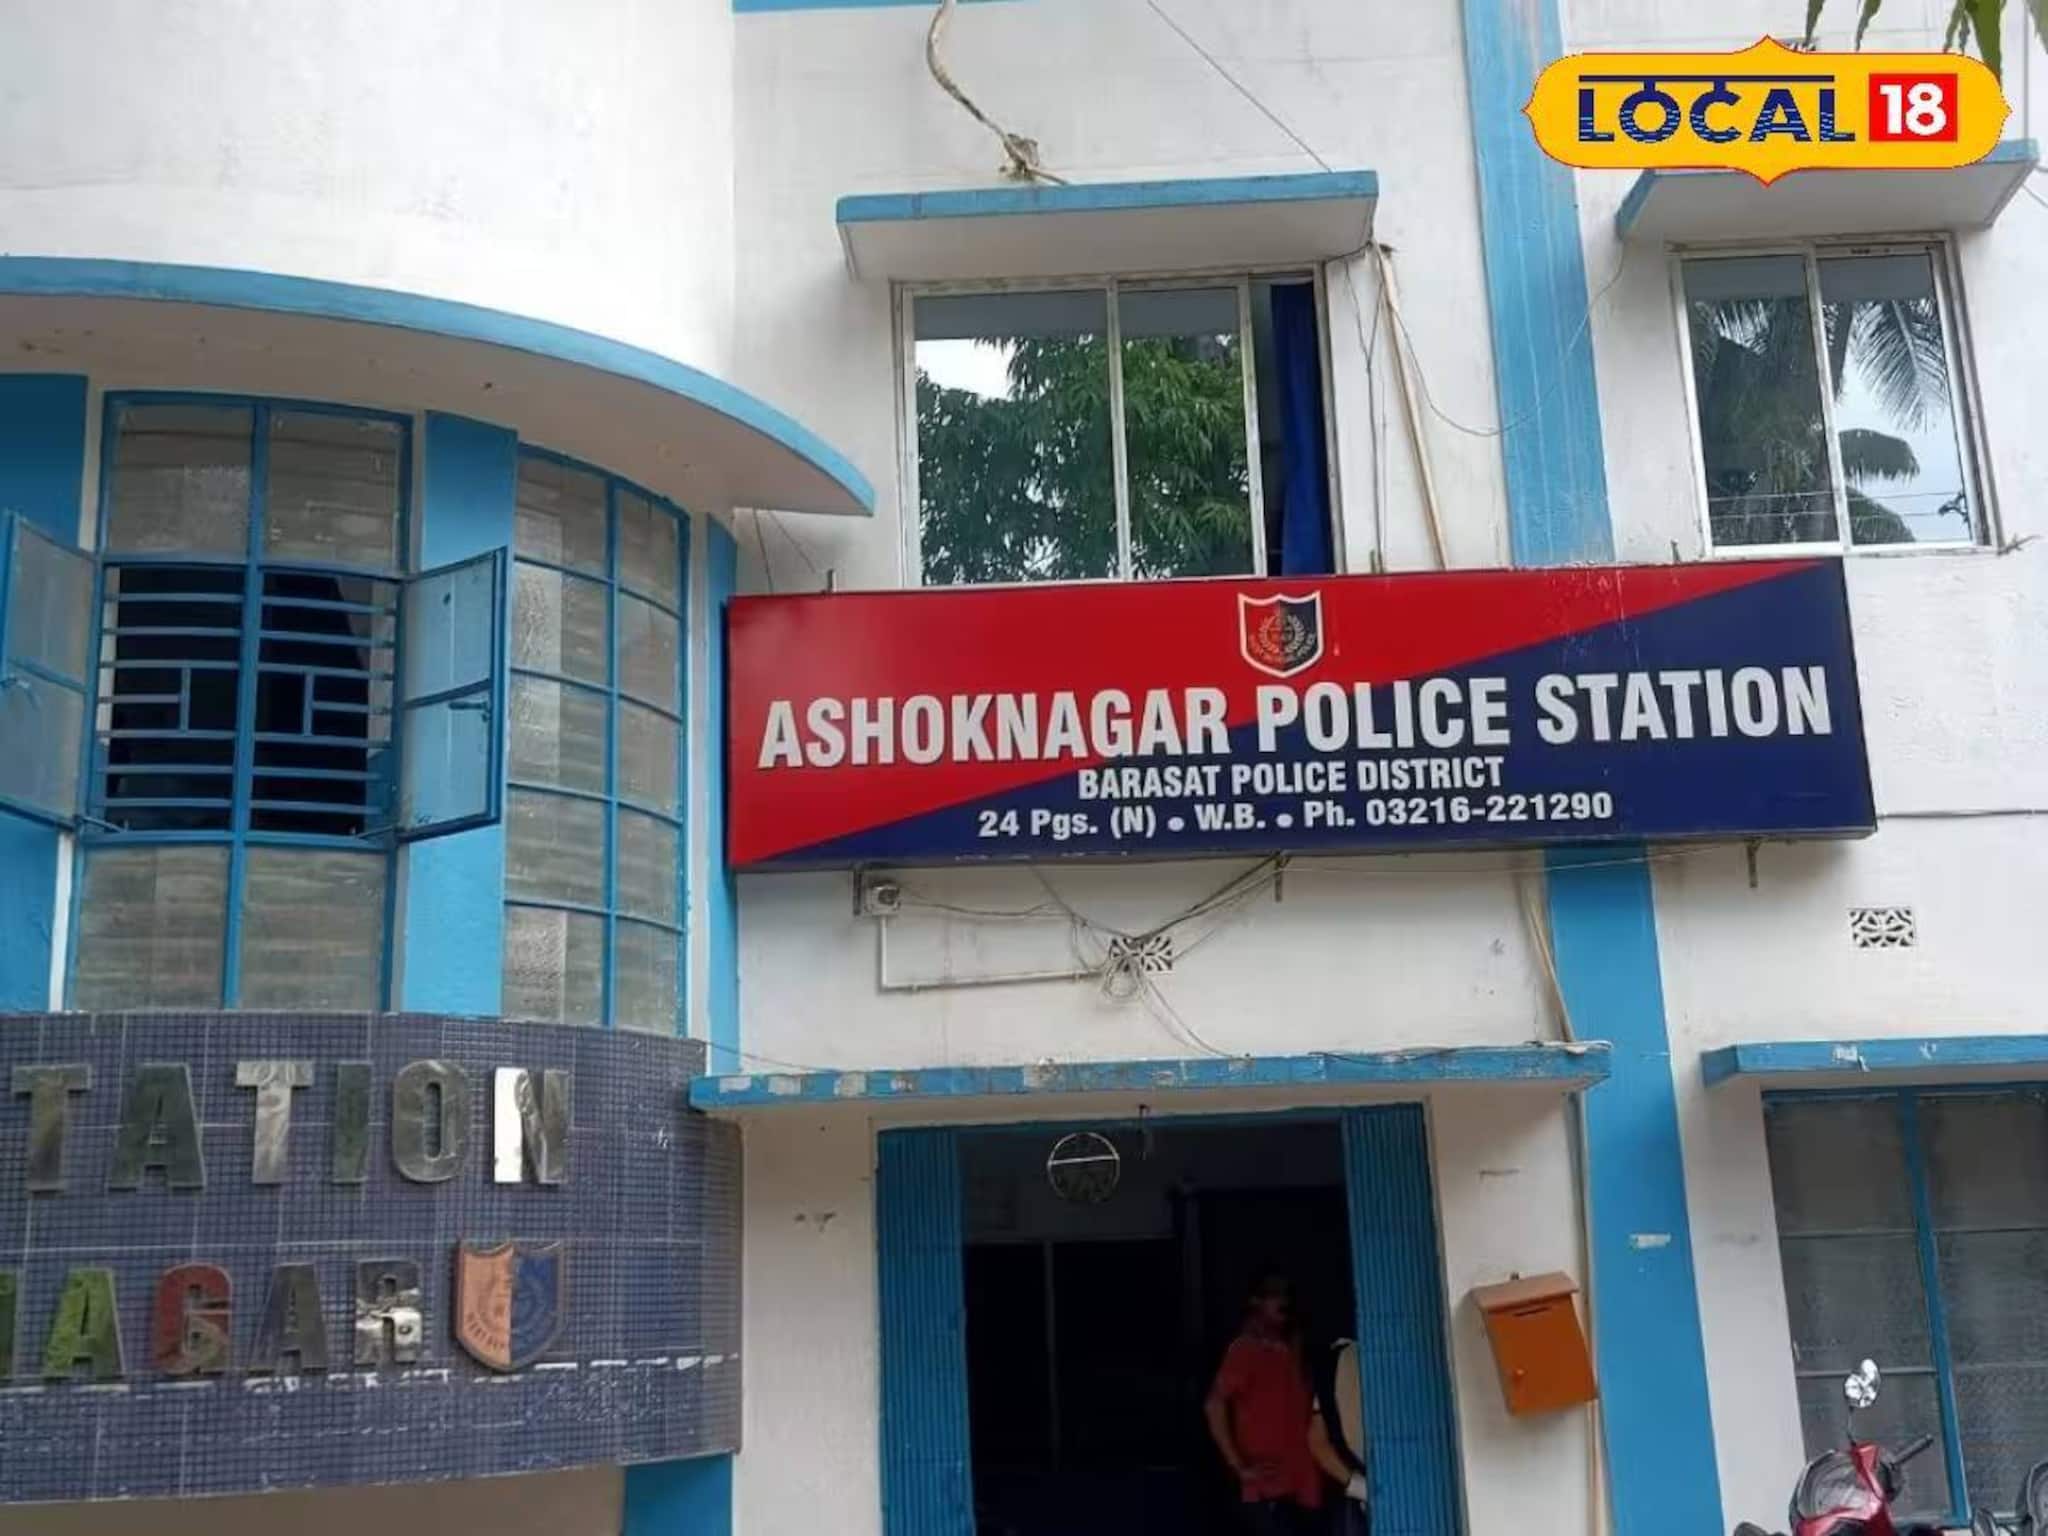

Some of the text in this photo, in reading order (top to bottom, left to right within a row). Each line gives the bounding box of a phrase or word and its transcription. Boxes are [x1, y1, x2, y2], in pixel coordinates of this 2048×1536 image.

[757, 665, 1832, 769] ASHOKNAGAR POLICE STATION
[1078, 756, 1505, 800] BARASAT POLICE DISTRICT
[977, 791, 1614, 841] 24 Pgs. (N) W.B. Ph. 03216-221290
